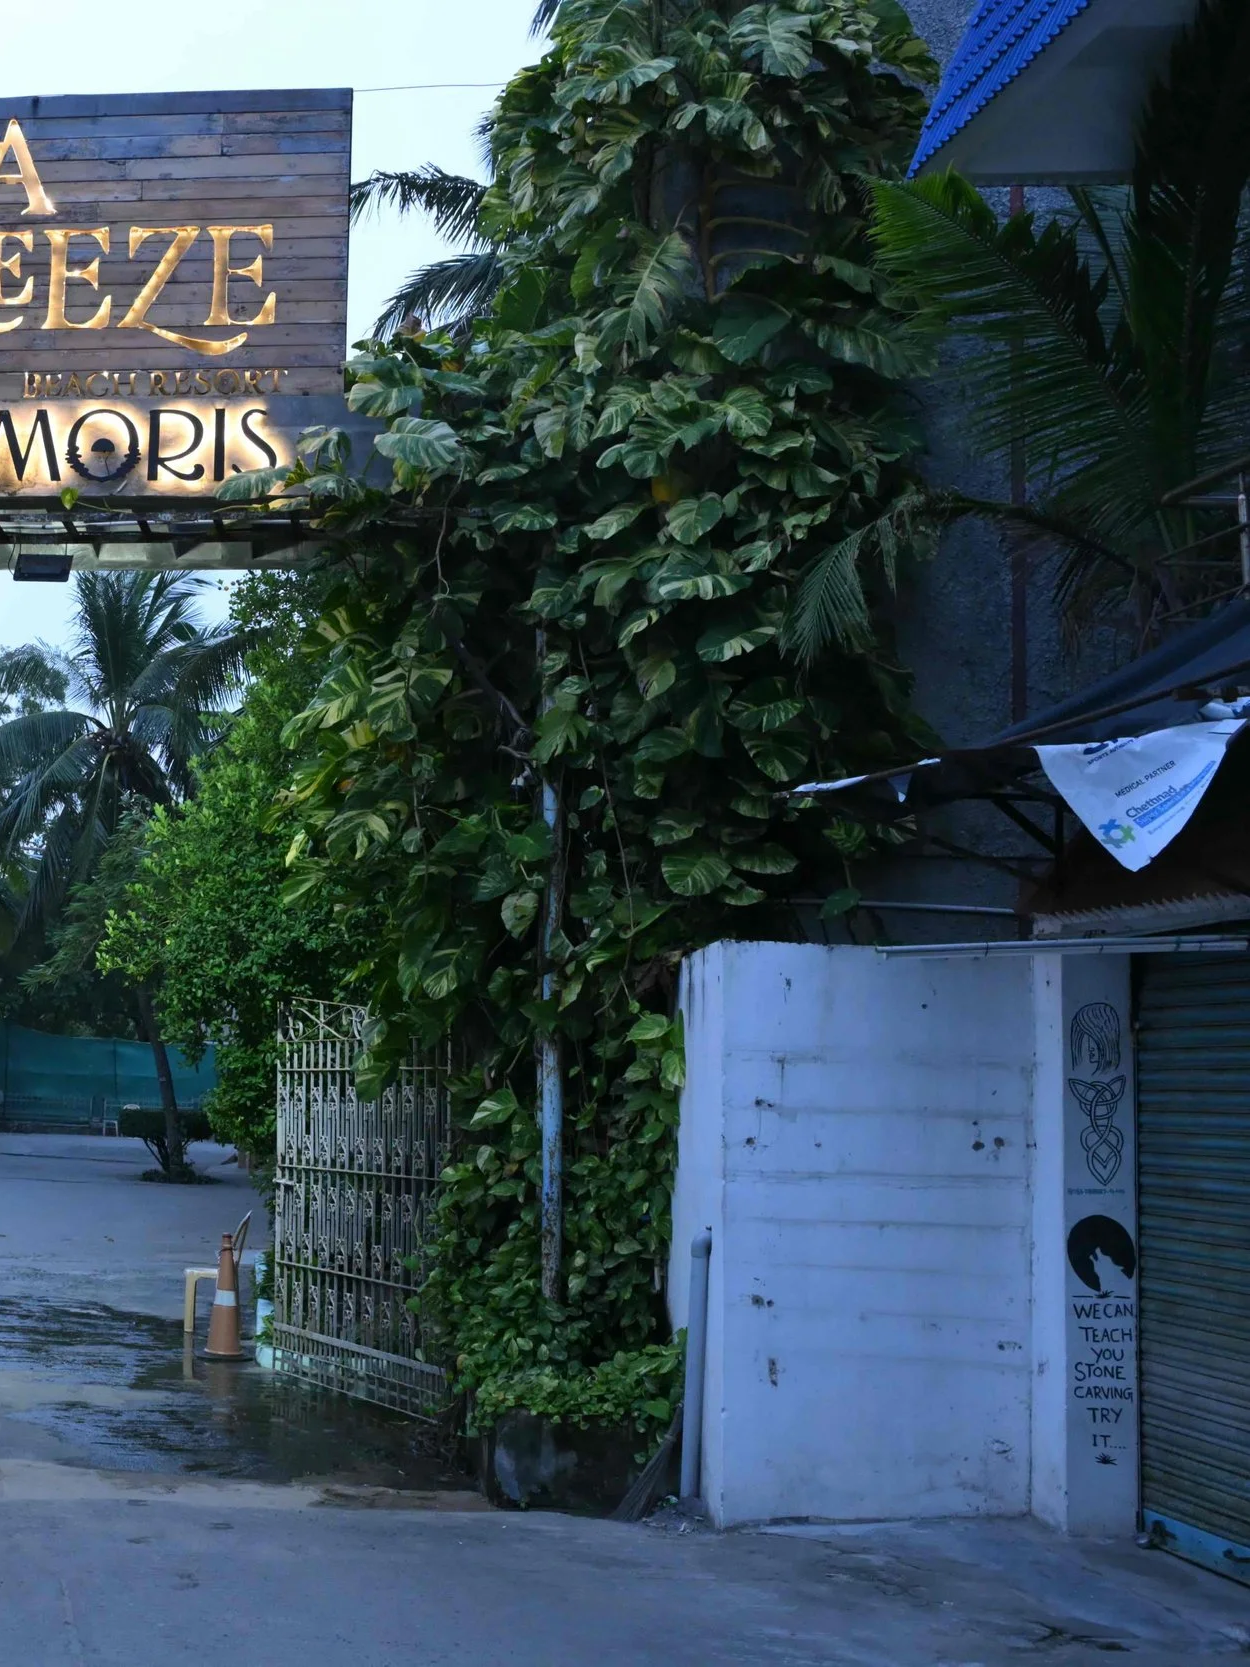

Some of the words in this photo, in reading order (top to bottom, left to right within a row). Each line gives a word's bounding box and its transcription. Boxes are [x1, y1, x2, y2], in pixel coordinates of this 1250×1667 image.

[23, 370, 137, 398] BEACH
[150, 368, 289, 397] RESORT
[1114, 778, 1146, 798] MEDICAL
[1144, 760, 1177, 782] PARTNER
[1073, 1303, 1101, 1319] WE
[1103, 1303, 1134, 1318] CAN
[1078, 1326, 1133, 1343] TEACH
[1090, 1347, 1124, 1363] YOU
[1074, 1362, 1126, 1382] STONE
[1073, 1386, 1133, 1404] CARVING
[1086, 1407, 1123, 1424] TRY
